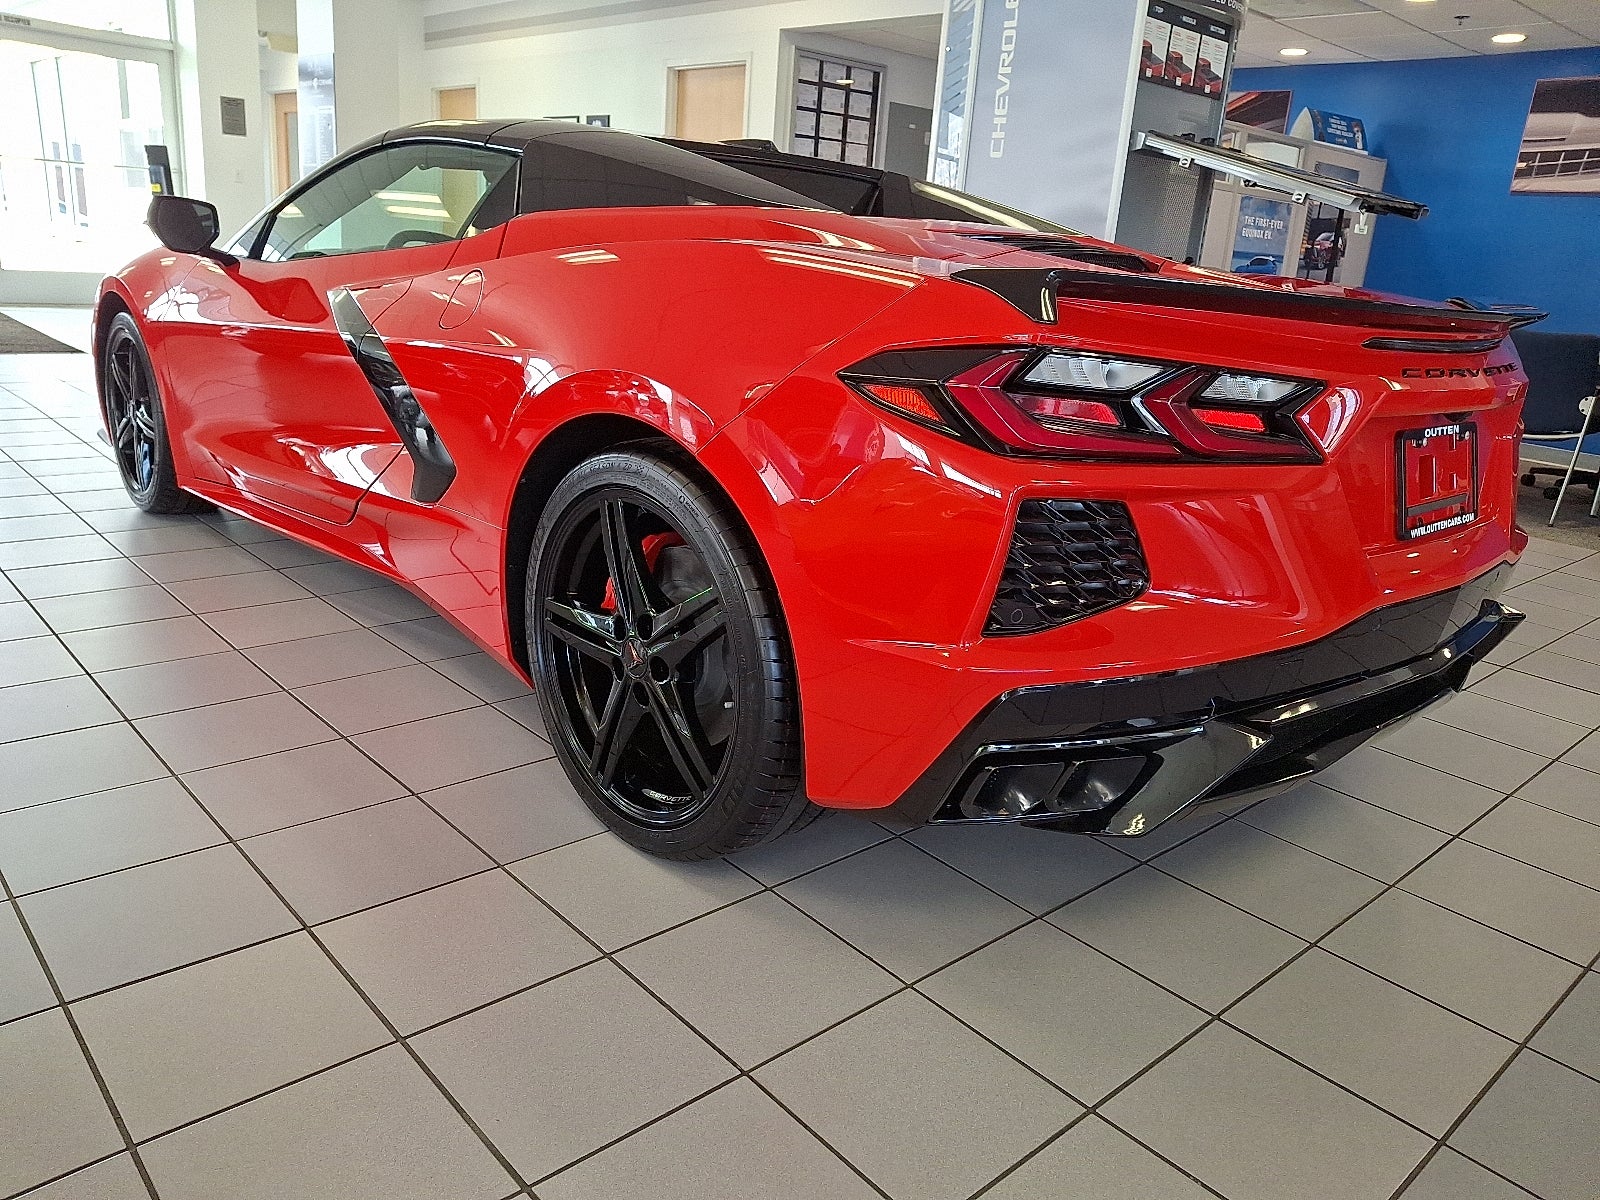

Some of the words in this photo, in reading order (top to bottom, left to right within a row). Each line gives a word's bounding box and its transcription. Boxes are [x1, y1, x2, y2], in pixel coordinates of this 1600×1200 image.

[1245, 216, 1254, 226] THE
[1255, 218, 1283, 229] FIRST-EVER
[1242, 227, 1263, 238] EQUINOX
[1401, 362, 1519, 378] CORVETTE
[1424, 425, 1460, 438] OUTTEN
[1410, 512, 1475, 539] WWW.OUTTENCARS.COM
[649, 791, 692, 802] CORVETTE
